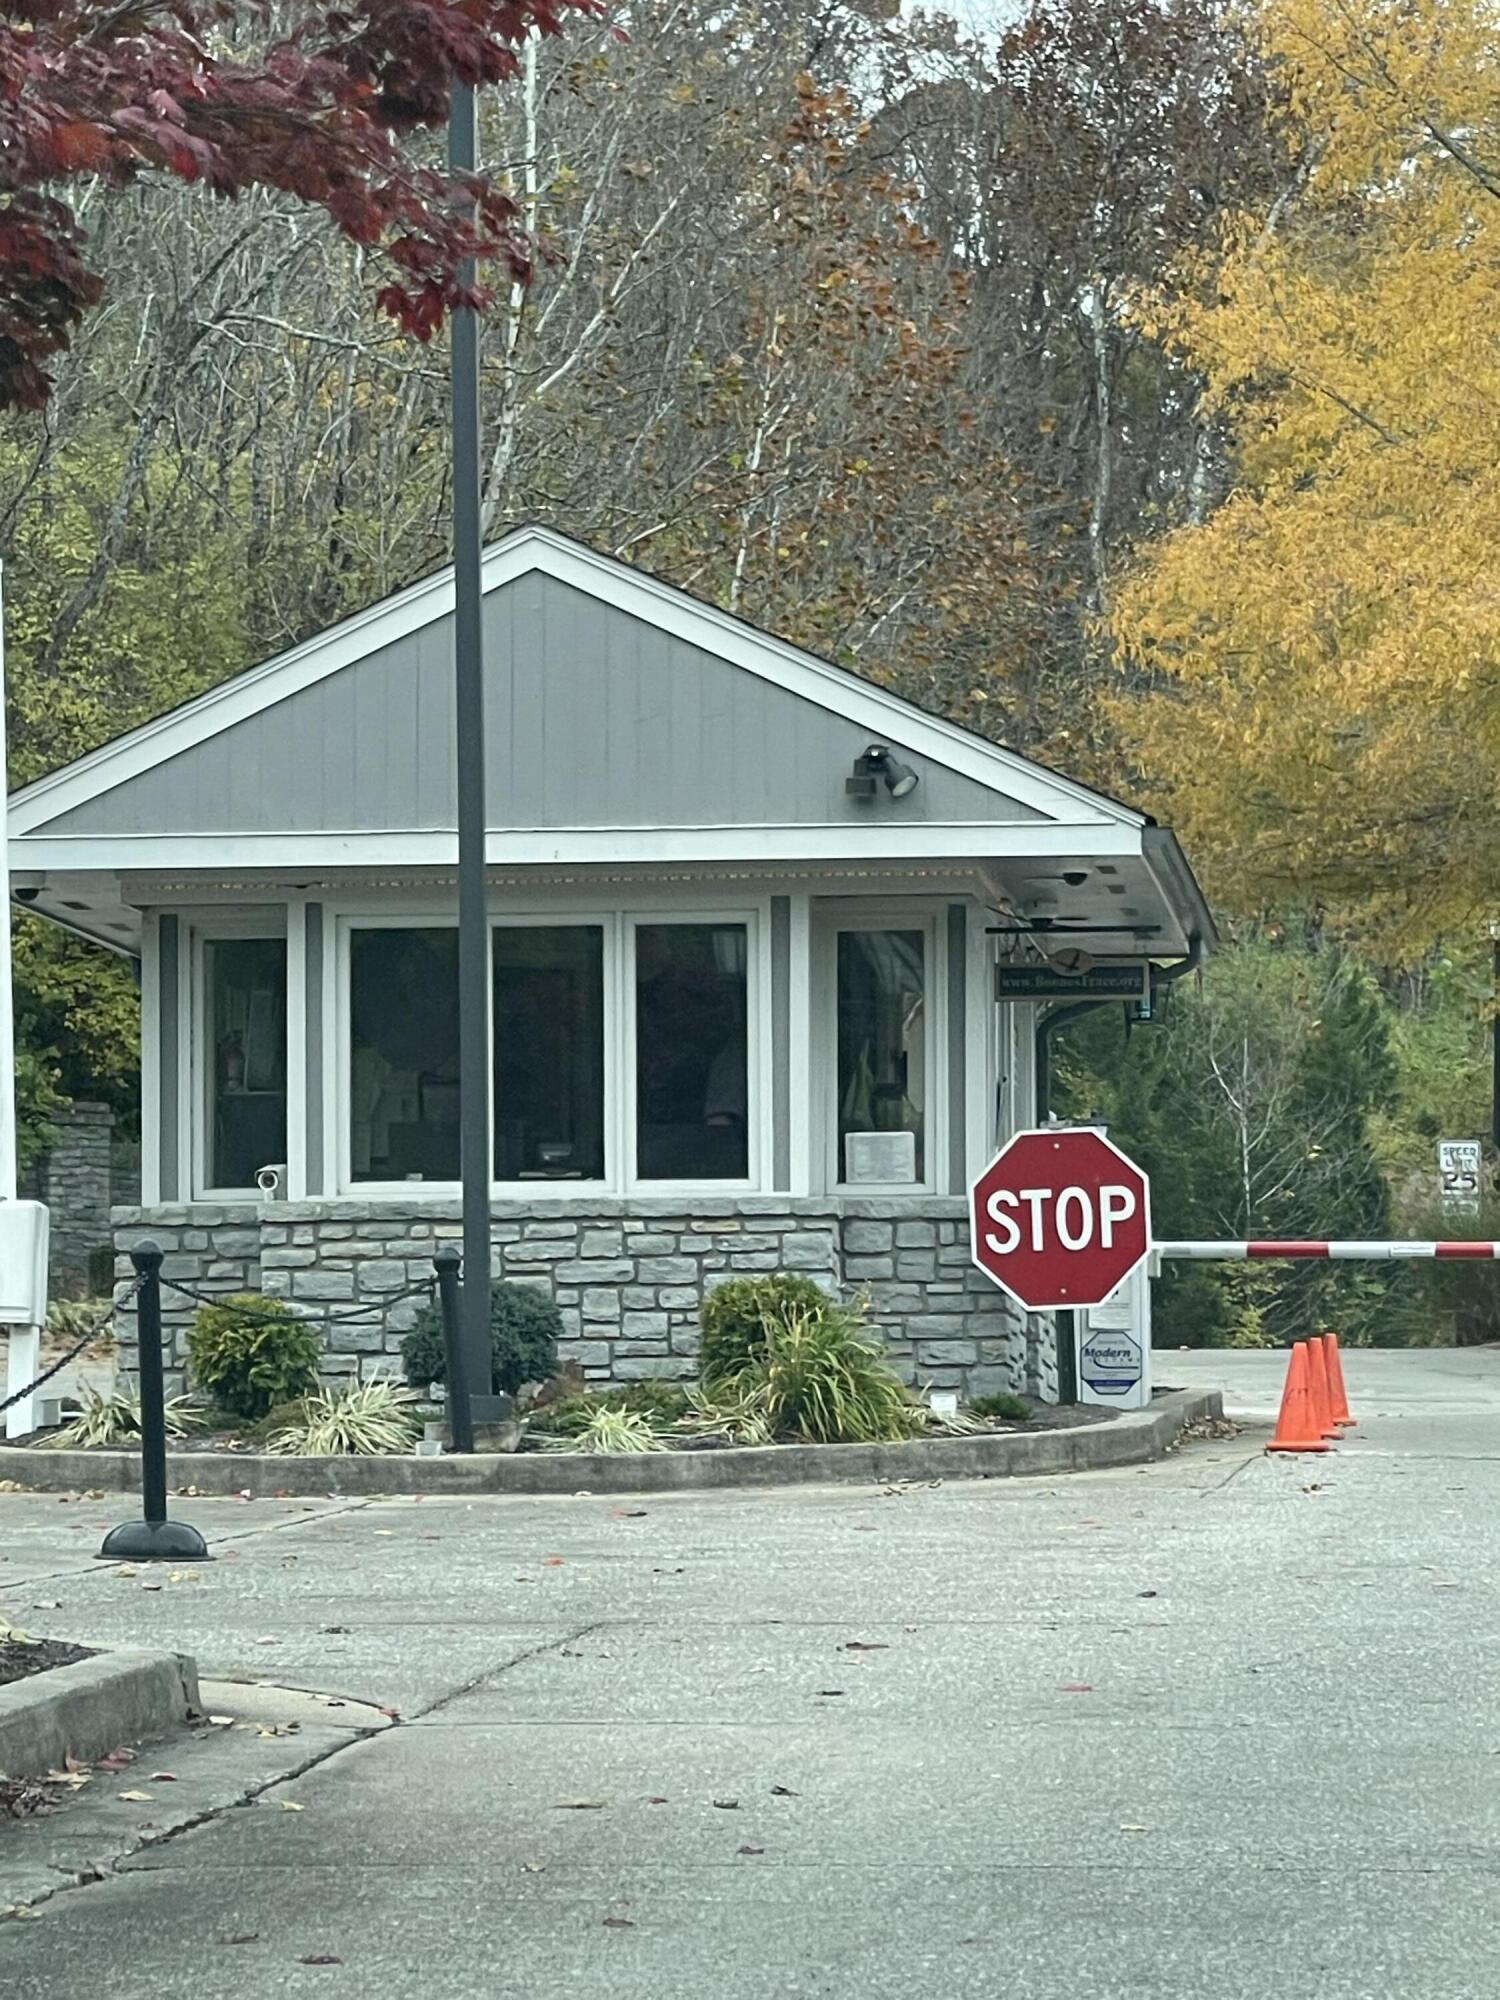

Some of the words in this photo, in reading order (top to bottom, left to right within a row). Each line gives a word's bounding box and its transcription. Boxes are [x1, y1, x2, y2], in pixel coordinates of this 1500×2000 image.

[1443, 1147, 1476, 1156] SPEED
[1443, 1172, 1477, 1190] 25
[985, 1185, 1136, 1255] STOP
[1084, 1347, 1131, 1358] Modern
